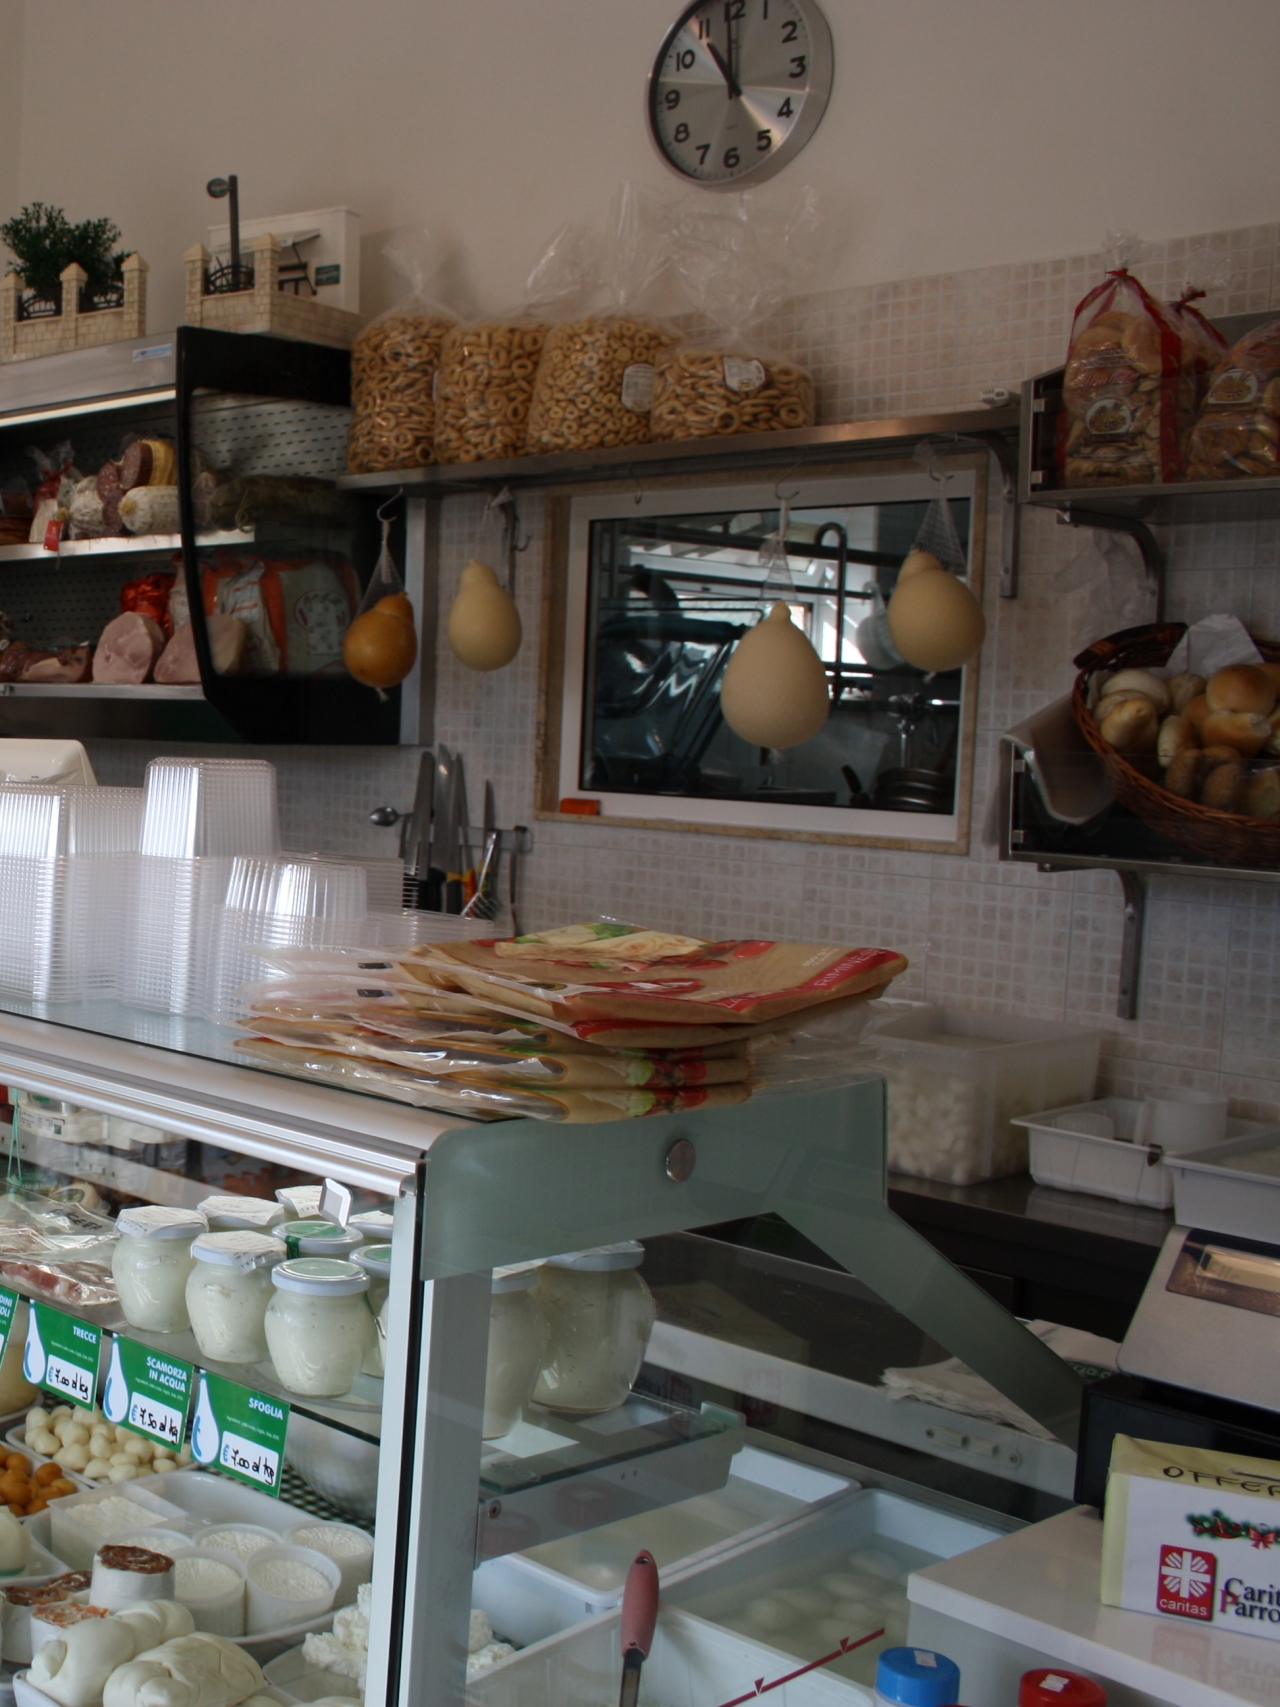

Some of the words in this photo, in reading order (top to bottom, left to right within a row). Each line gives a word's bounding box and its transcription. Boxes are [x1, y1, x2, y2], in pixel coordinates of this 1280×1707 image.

[763, 0, 768, 20] 1
[698, 18, 711, 40] 11
[781, 20, 798, 43] 2
[675, 49, 696, 72] 10
[788, 55, 806, 78] 3
[664, 89, 681, 110] 9
[777, 97, 793, 118] 4
[674, 123, 690, 143] 8
[756, 129, 771, 151] 5
[695, 143, 711, 165] 7
[723, 147, 740, 168] 6
[814, 947, 887, 988] RIMINESE
[72, 1325, 97, 1344] TRECCE
[146, 1355, 187, 1382] SCAMORZA
[148, 1369, 158, 1382] IN
[158, 1375, 186, 1393] ACQUA
[248, 1397, 284, 1420] SFOGLIA
[1159, 1597, 1208, 1617] caritas
